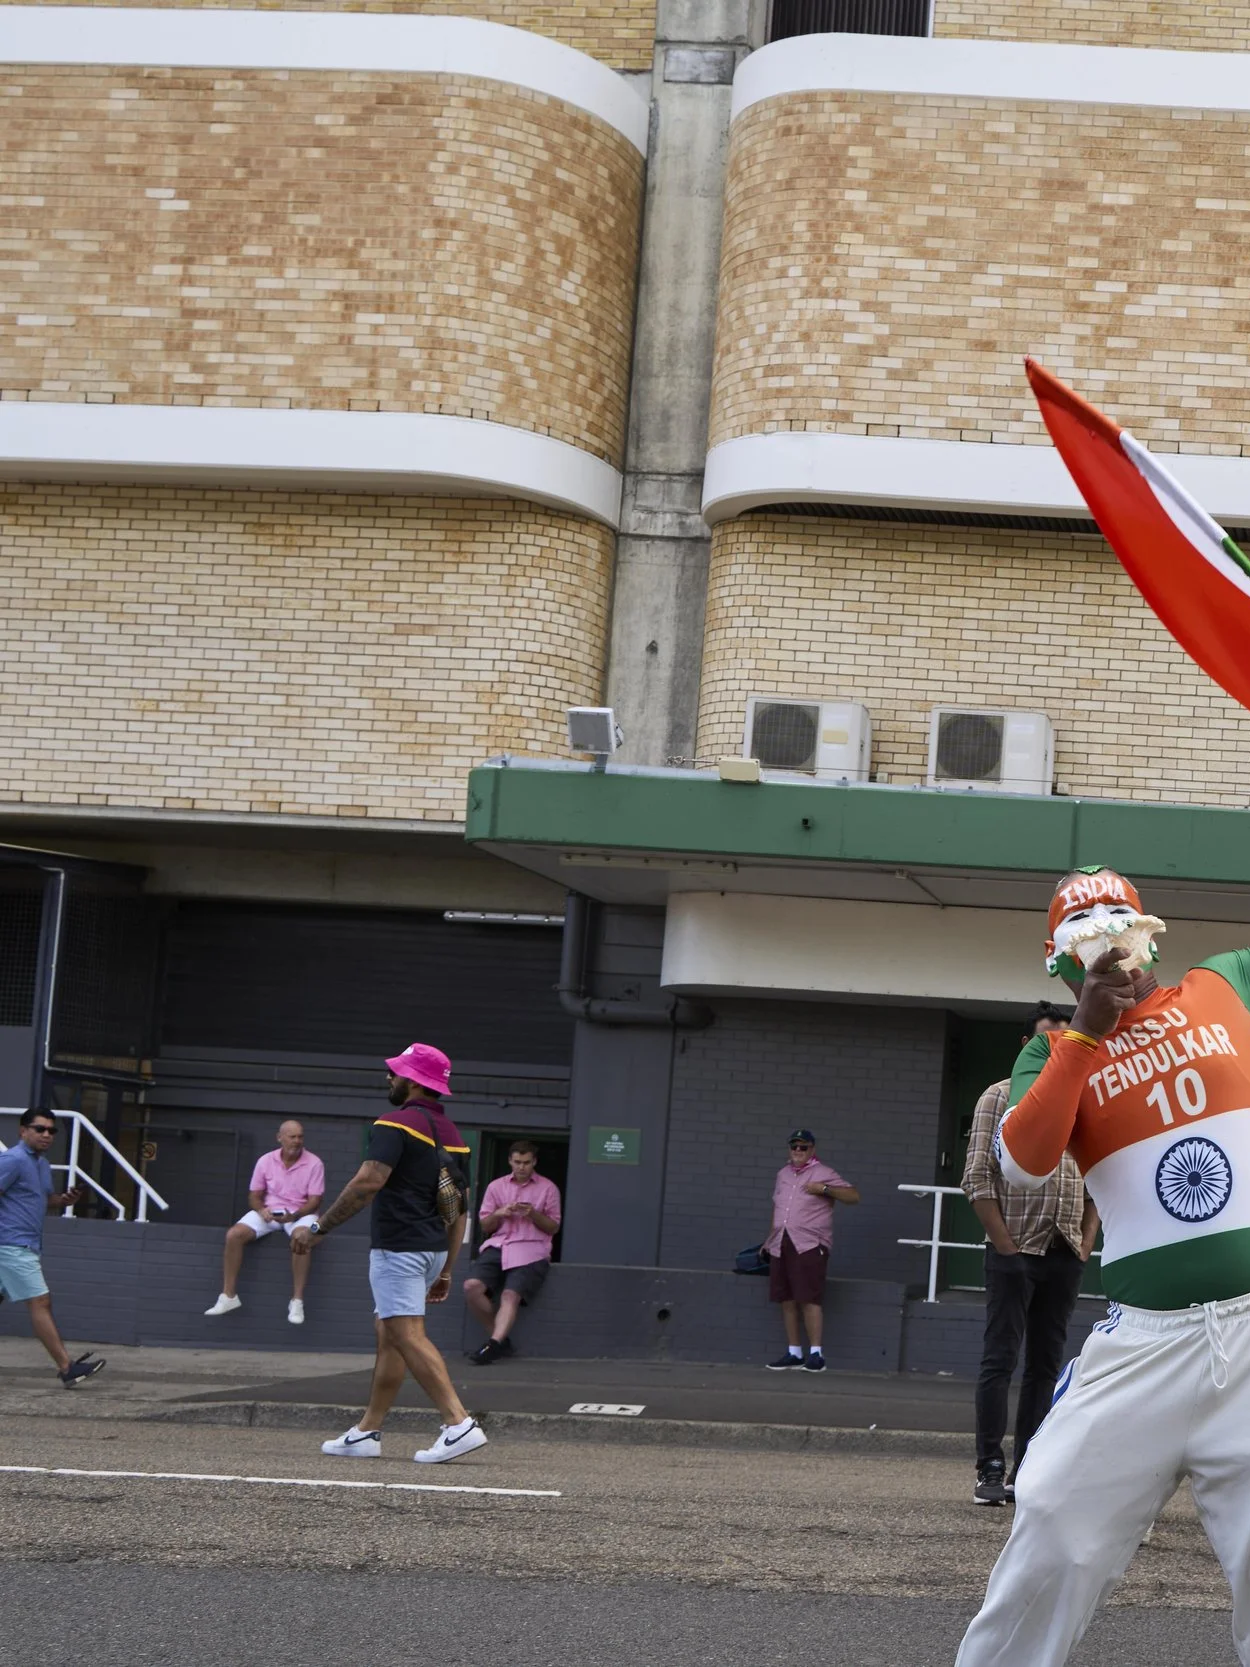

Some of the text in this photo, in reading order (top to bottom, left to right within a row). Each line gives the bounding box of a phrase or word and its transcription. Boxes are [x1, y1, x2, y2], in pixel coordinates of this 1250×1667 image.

[1059, 877, 1127, 909] INDIA
[1106, 1007, 1188, 1058] MISS-U
[1088, 1023, 1238, 1106] TENDULKAR
[1146, 1067, 1207, 1126] 10
